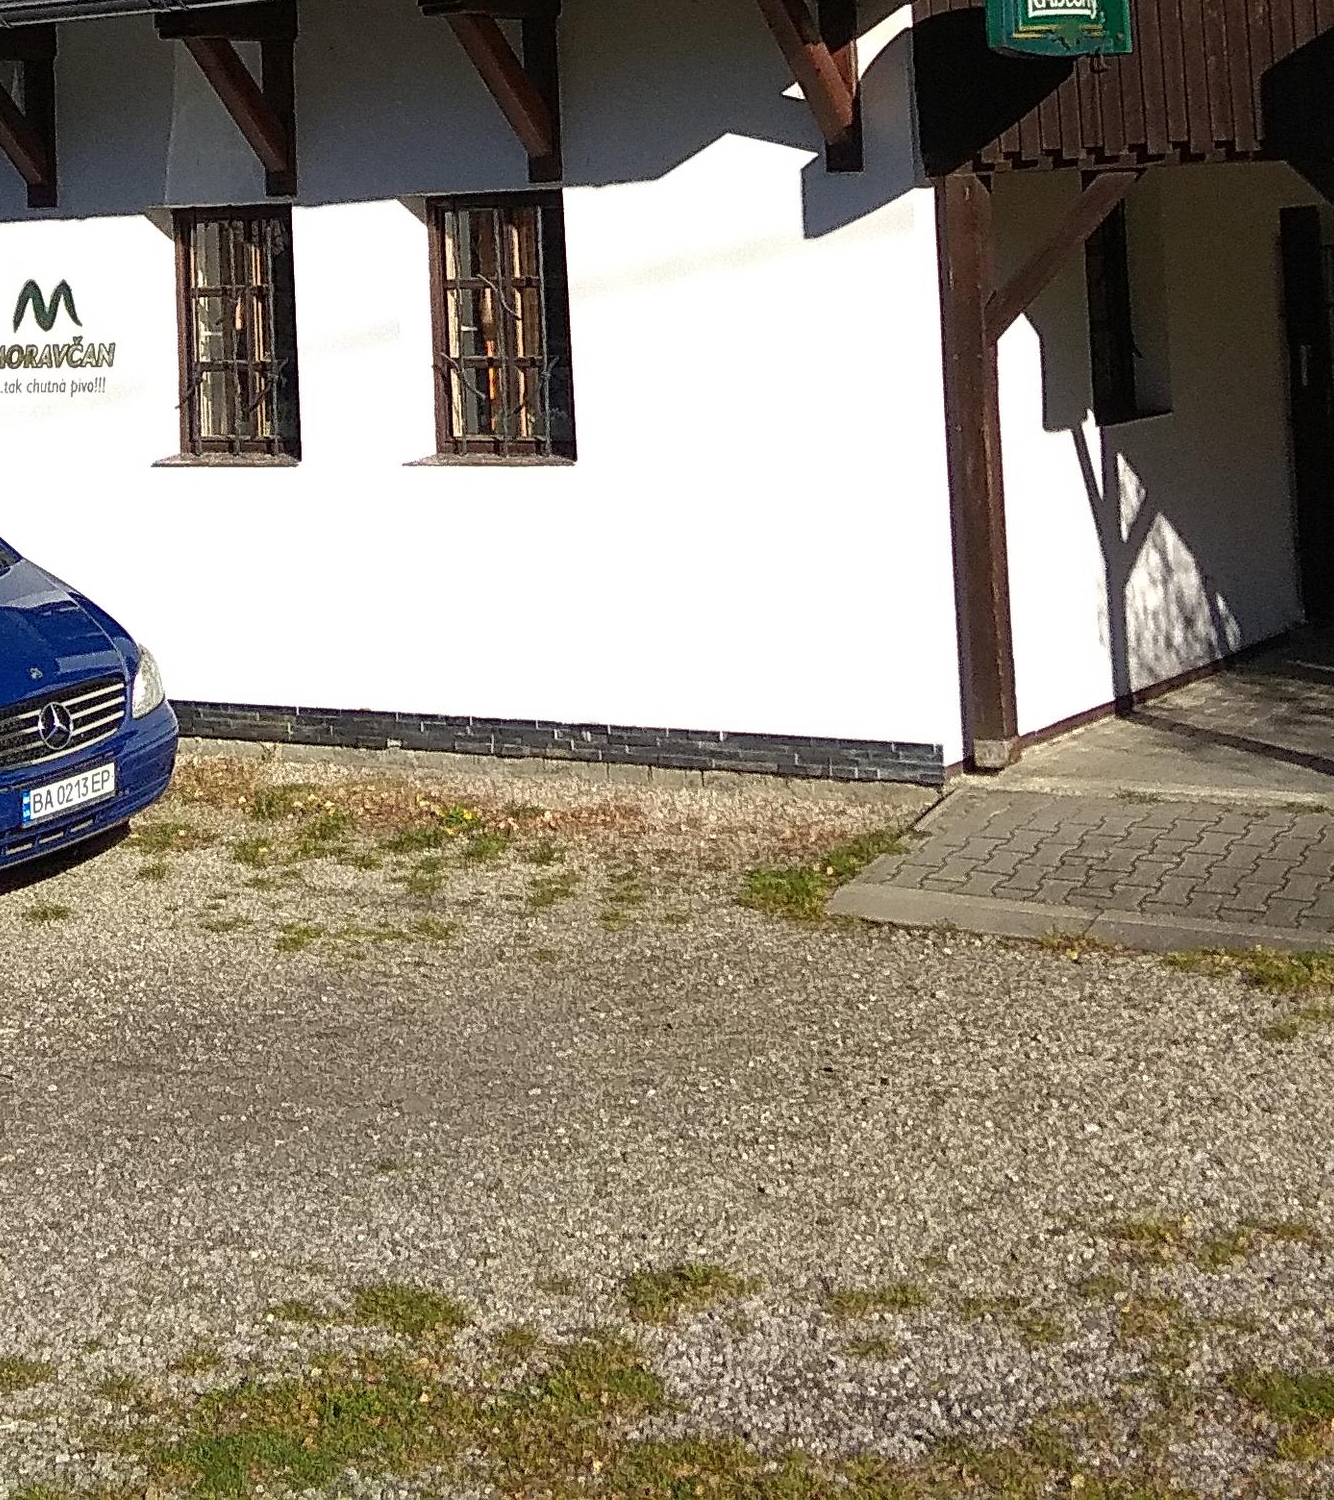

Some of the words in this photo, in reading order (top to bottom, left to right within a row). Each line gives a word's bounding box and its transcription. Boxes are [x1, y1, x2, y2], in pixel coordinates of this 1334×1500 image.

[33, 789, 54, 814] BA
[57, 776, 89, 805] 0213
[92, 769, 111, 793] EP
